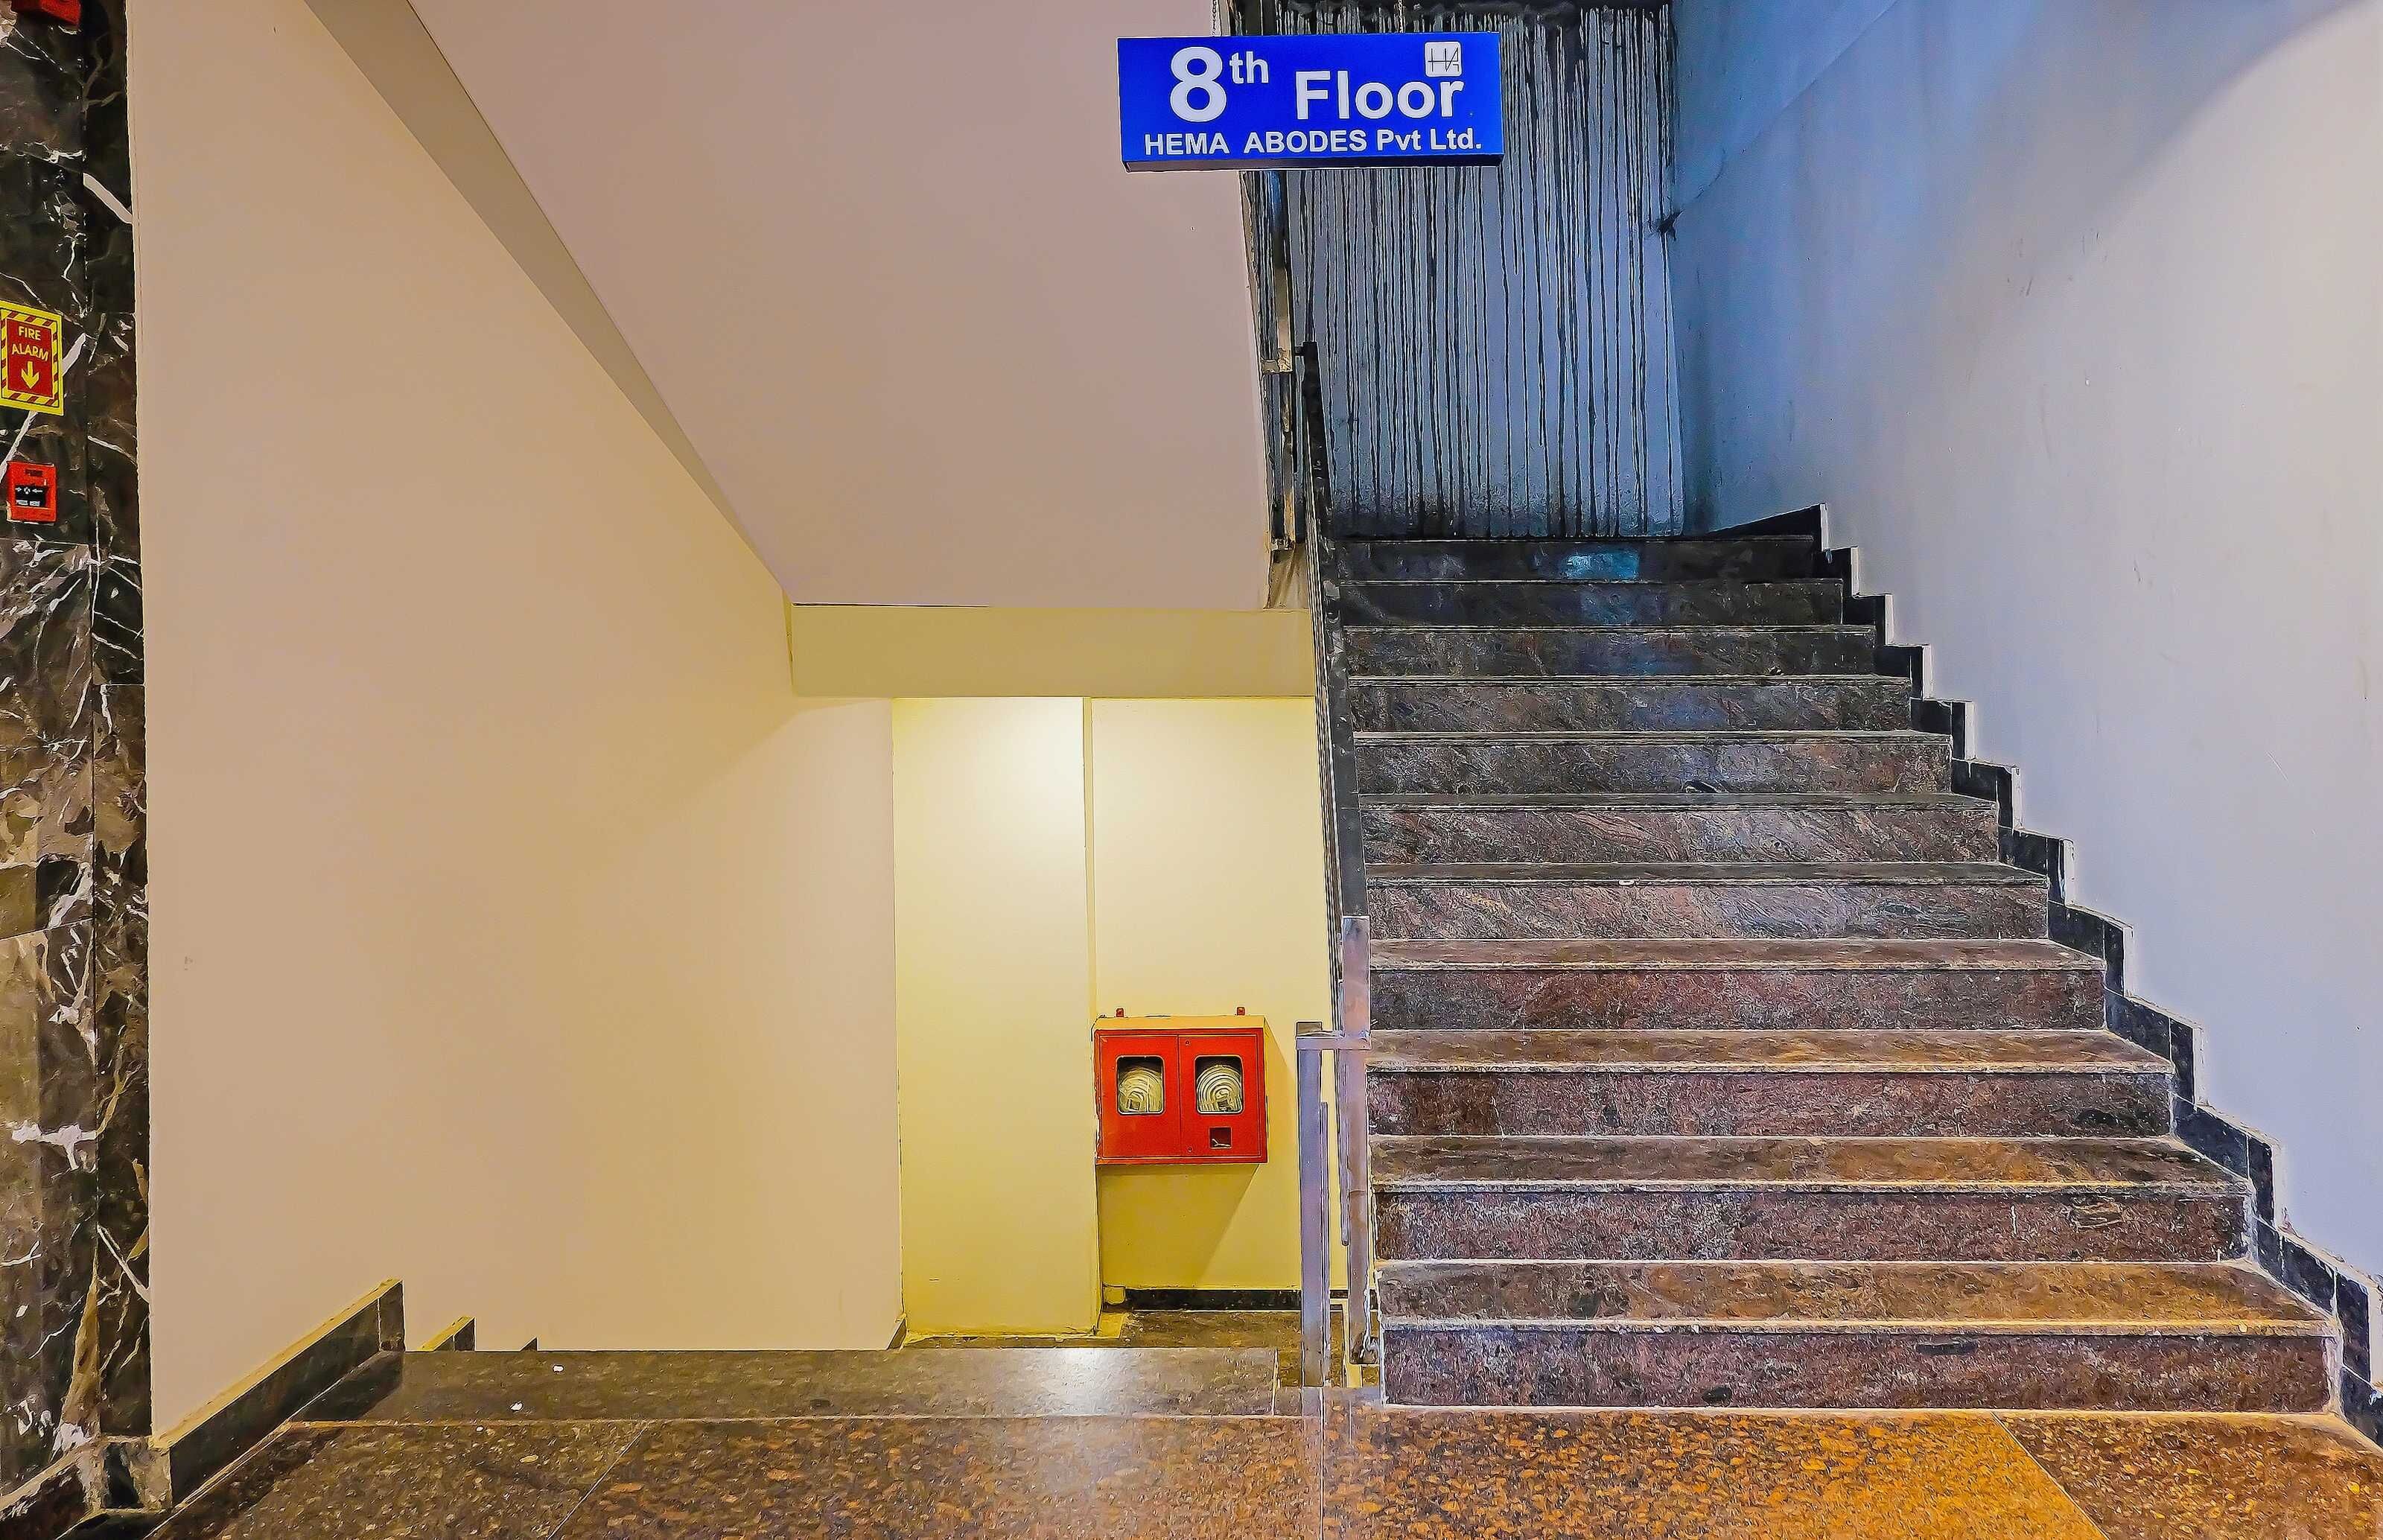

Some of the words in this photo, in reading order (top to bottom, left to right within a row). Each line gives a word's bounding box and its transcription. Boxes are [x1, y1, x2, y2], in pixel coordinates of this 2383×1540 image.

[1296, 70, 1465, 120] Floor
[1145, 133, 1230, 155] HEMA
[1243, 130, 1367, 153] ABODES
[1377, 130, 1422, 150] Pvt
[1430, 128, 1482, 150] Ltd.
[18, 325, 42, 341] FIRE
[11, 343, 49, 362] ALARM
